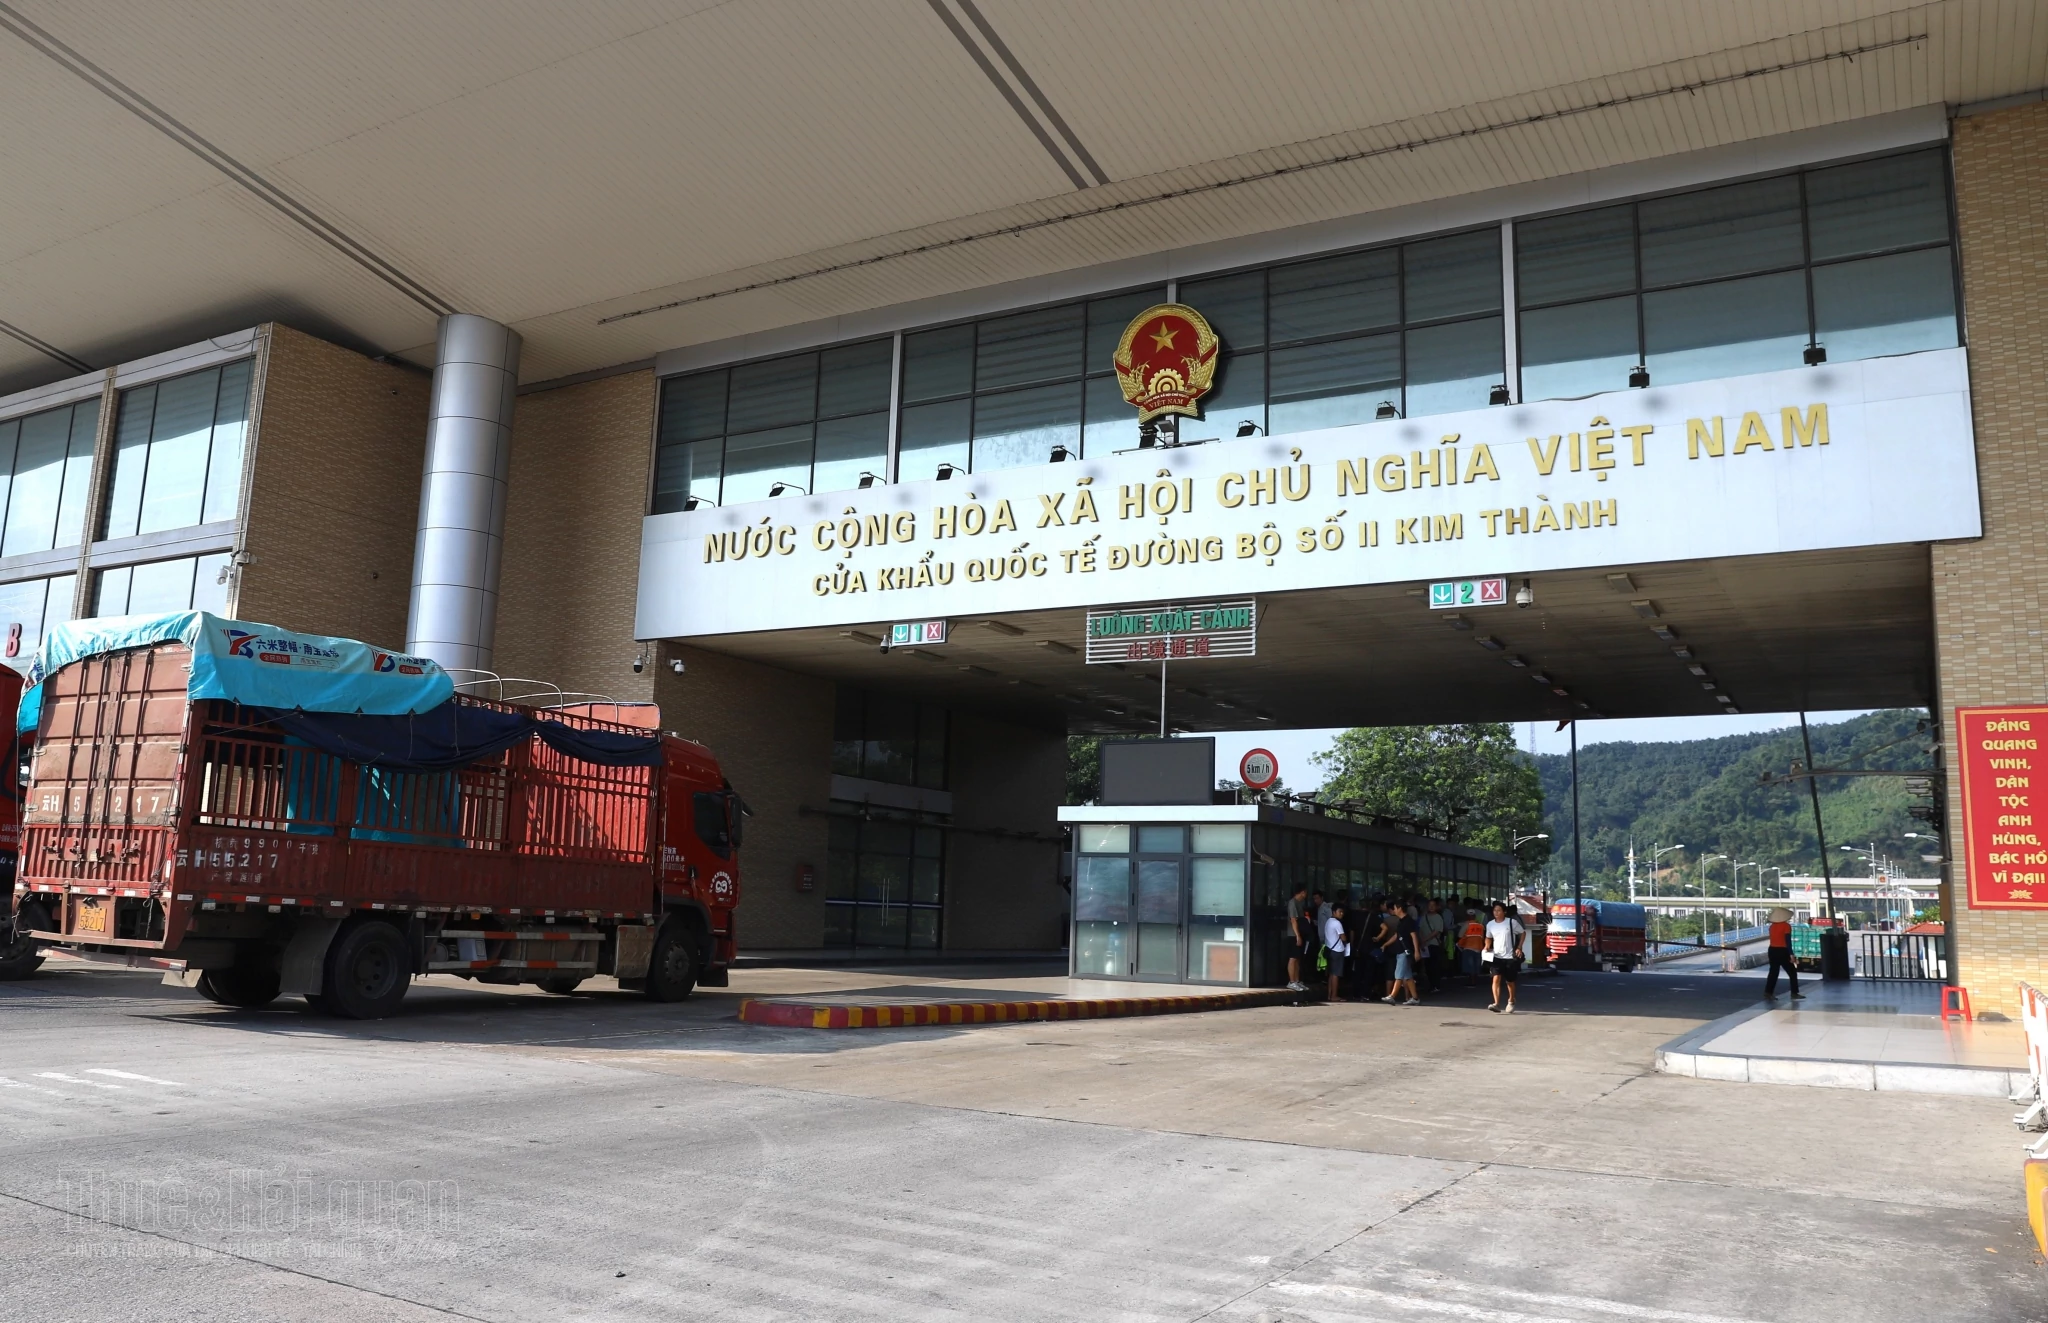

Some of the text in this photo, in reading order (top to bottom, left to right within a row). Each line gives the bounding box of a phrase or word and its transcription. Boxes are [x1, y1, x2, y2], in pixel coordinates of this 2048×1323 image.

[703, 402, 1831, 564] NƯỚC CỘNG HÒA XÃ HỘI CHỦ NGHĨA VIỆT NAM
[813, 559, 867, 597] CỬA
[876, 549, 954, 591] KHẨU
[964, 541, 1048, 581] QUỐC
[1060, 534, 1100, 574] TẾ
[1107, 531, 1223, 571] ĐƯỜNG
[1235, 521, 1281, 566] BỘ
[1296, 508, 1348, 552] SỐ
[1395, 512, 1464, 545] KIM
[1480, 493, 1618, 537] THÀNH
[1460, 581, 1474, 604] 2
[1090, 602, 1250, 637] LUỒNG XUẤT CẢNH
[5, 623, 22, 657] B
[914, 623, 922, 642] 1
[1126, 636, 1211, 661] 出境通道
[1985, 717, 2031, 732] ĐẢNG
[1982, 739, 2038, 751] QUANG
[1989, 758, 2032, 770] VINH,
[1995, 776, 2029, 789] DÂN
[1998, 795, 2029, 809] TỘC
[1998, 815, 2032, 827] ANH
[1992, 832, 2042, 847] HÙNG,
[1989, 849, 2048, 865] BÁC HỒ
[1992, 871, 2046, 886] VĨ ĐẠI!
